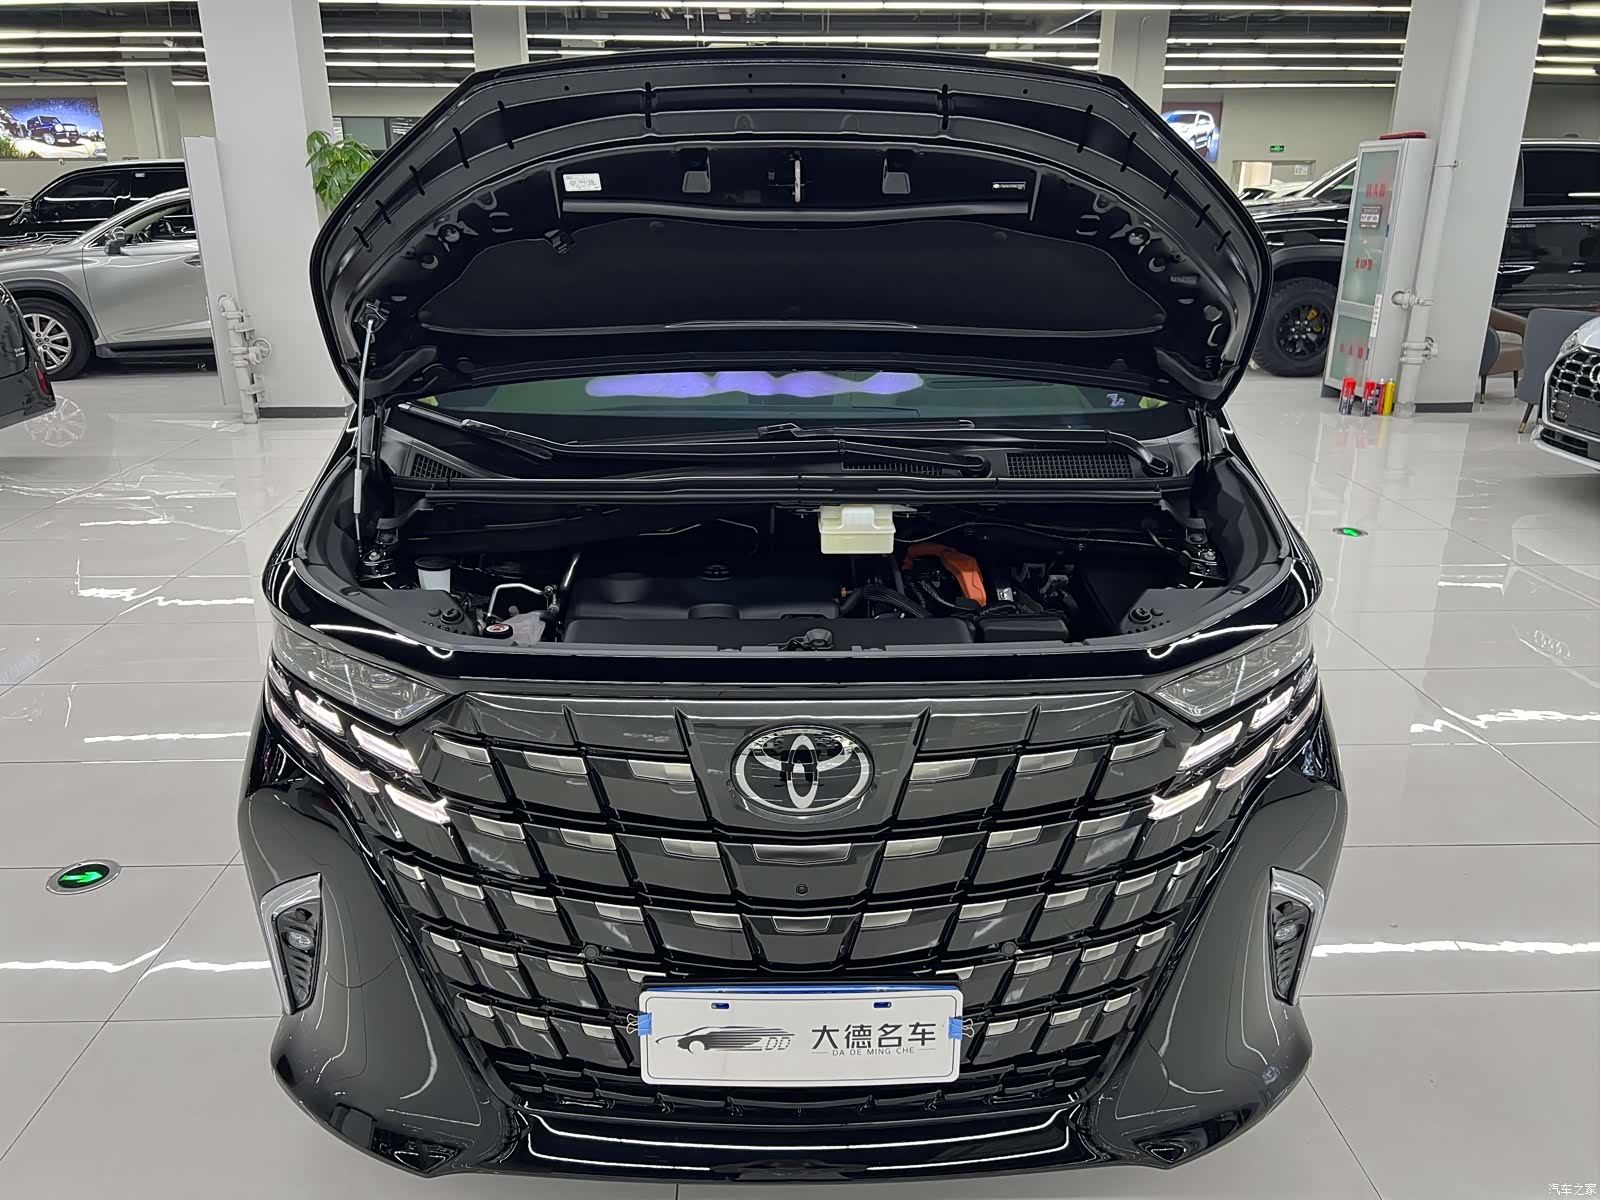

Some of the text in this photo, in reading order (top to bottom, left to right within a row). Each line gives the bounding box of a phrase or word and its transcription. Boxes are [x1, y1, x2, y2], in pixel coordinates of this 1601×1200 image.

[811, 1021, 937, 1050] 大德名车
[765, 1036, 791, 1051] DD
[832, 1049, 845, 1057] DA
[866, 1048, 891, 1056] MING
[895, 1046, 915, 1054] CHE
